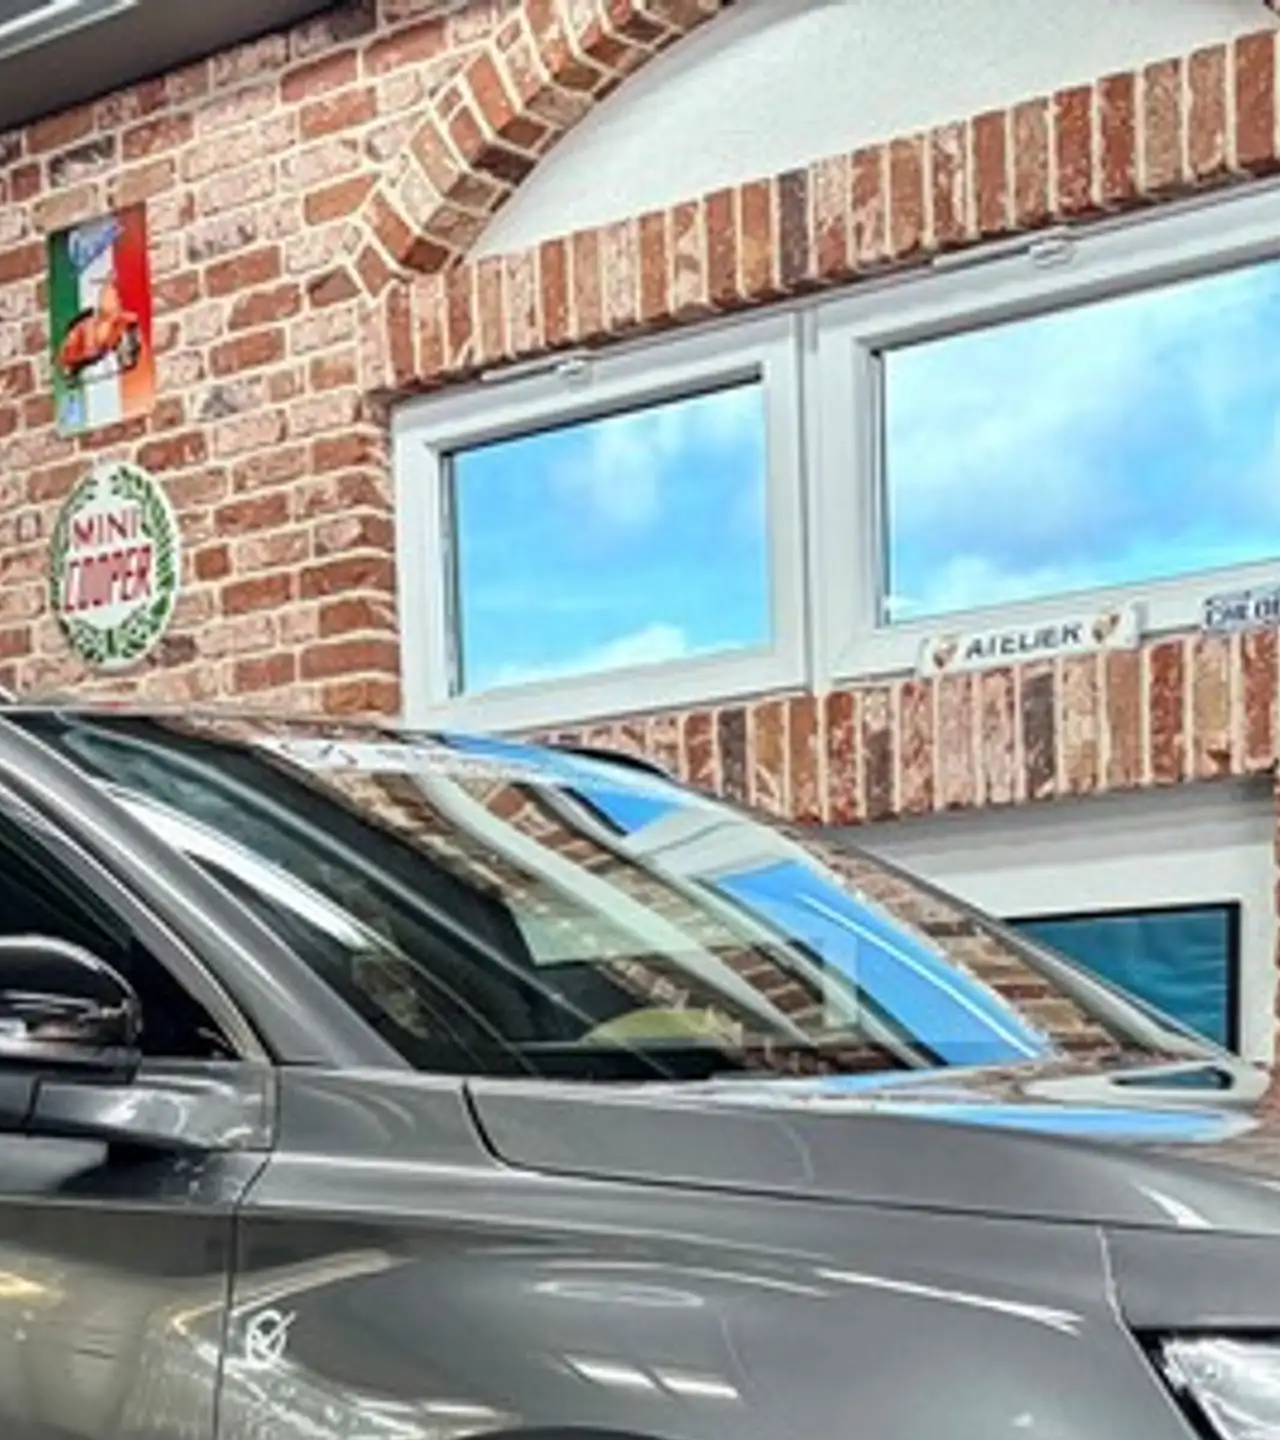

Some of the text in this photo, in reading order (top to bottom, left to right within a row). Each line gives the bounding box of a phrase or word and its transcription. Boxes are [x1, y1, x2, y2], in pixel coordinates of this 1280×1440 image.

[73, 507, 139, 552] MINI
[64, 544, 152, 611] COOPER
[966, 622, 1083, 660] ATELIER
